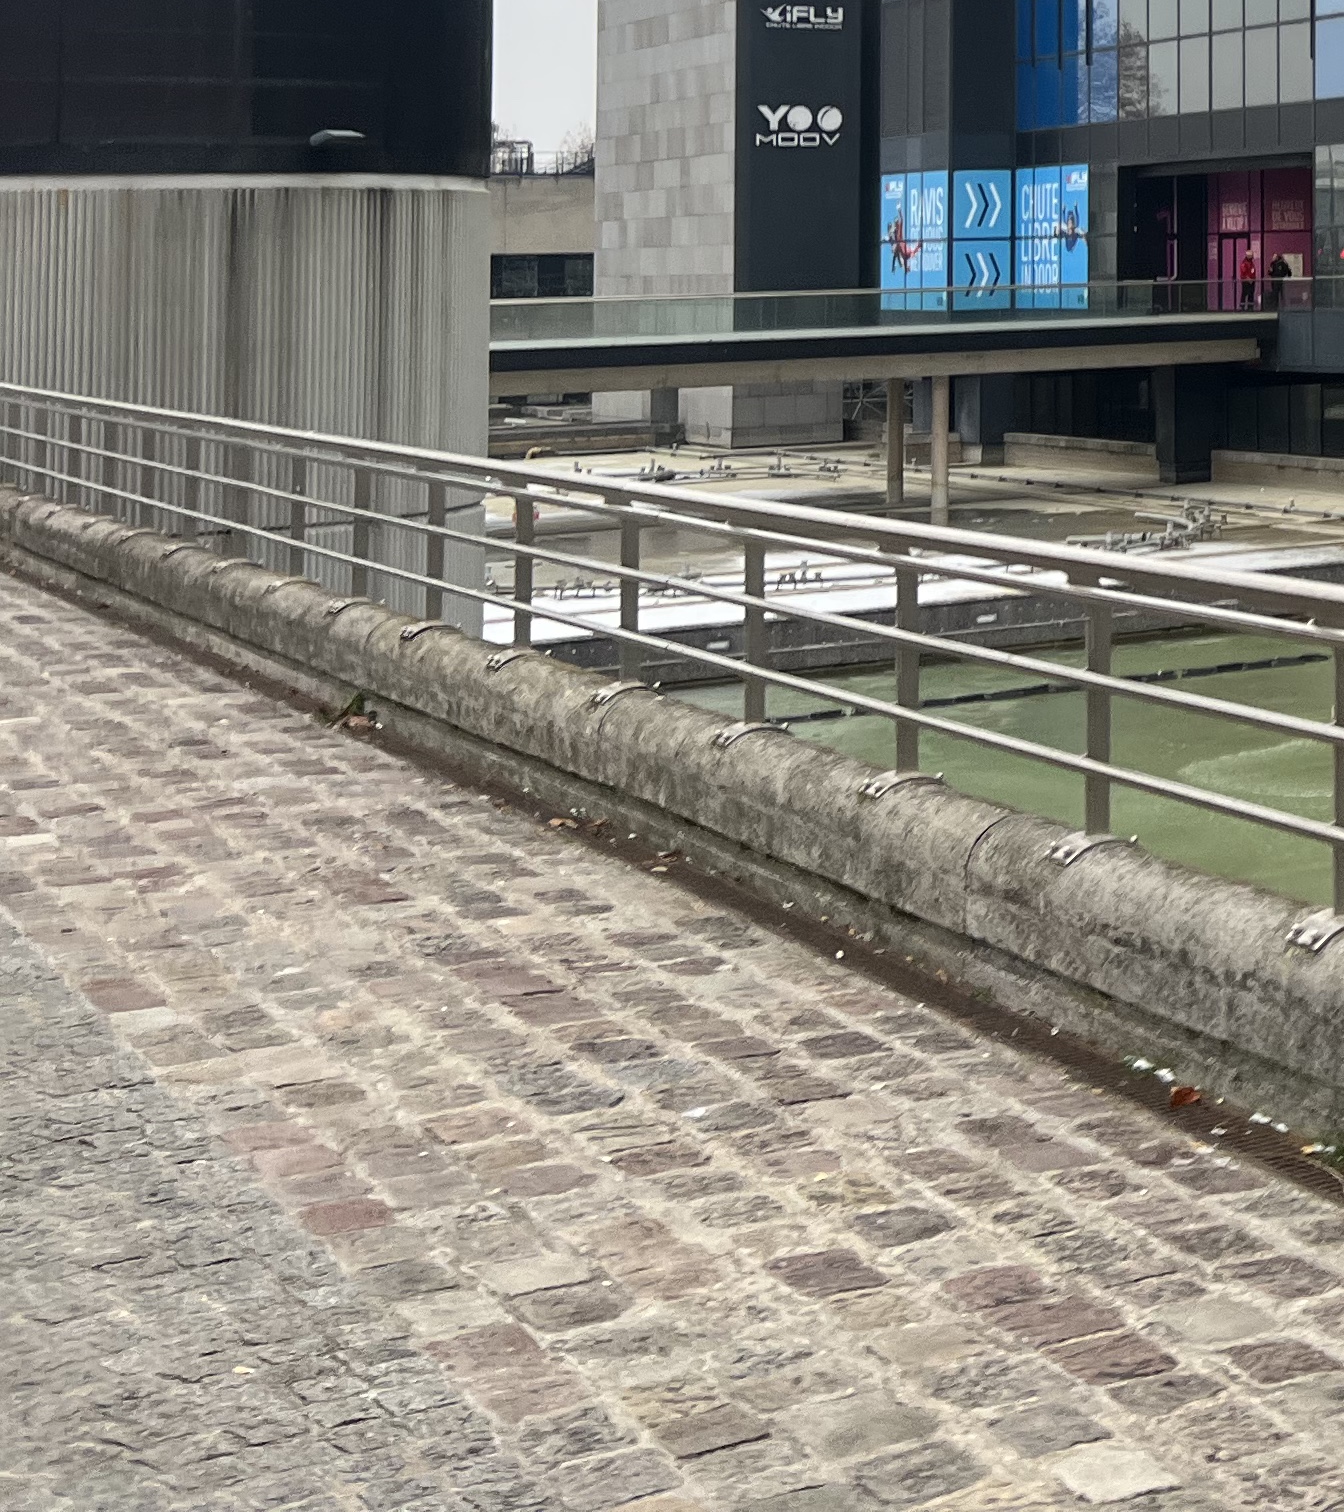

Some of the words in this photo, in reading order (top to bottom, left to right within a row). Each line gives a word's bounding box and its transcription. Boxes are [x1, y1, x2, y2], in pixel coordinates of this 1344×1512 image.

[785, 5, 844, 24] iFLY
[755, 132, 841, 147] MOOV
[1021, 182, 1059, 221] CHUTE
